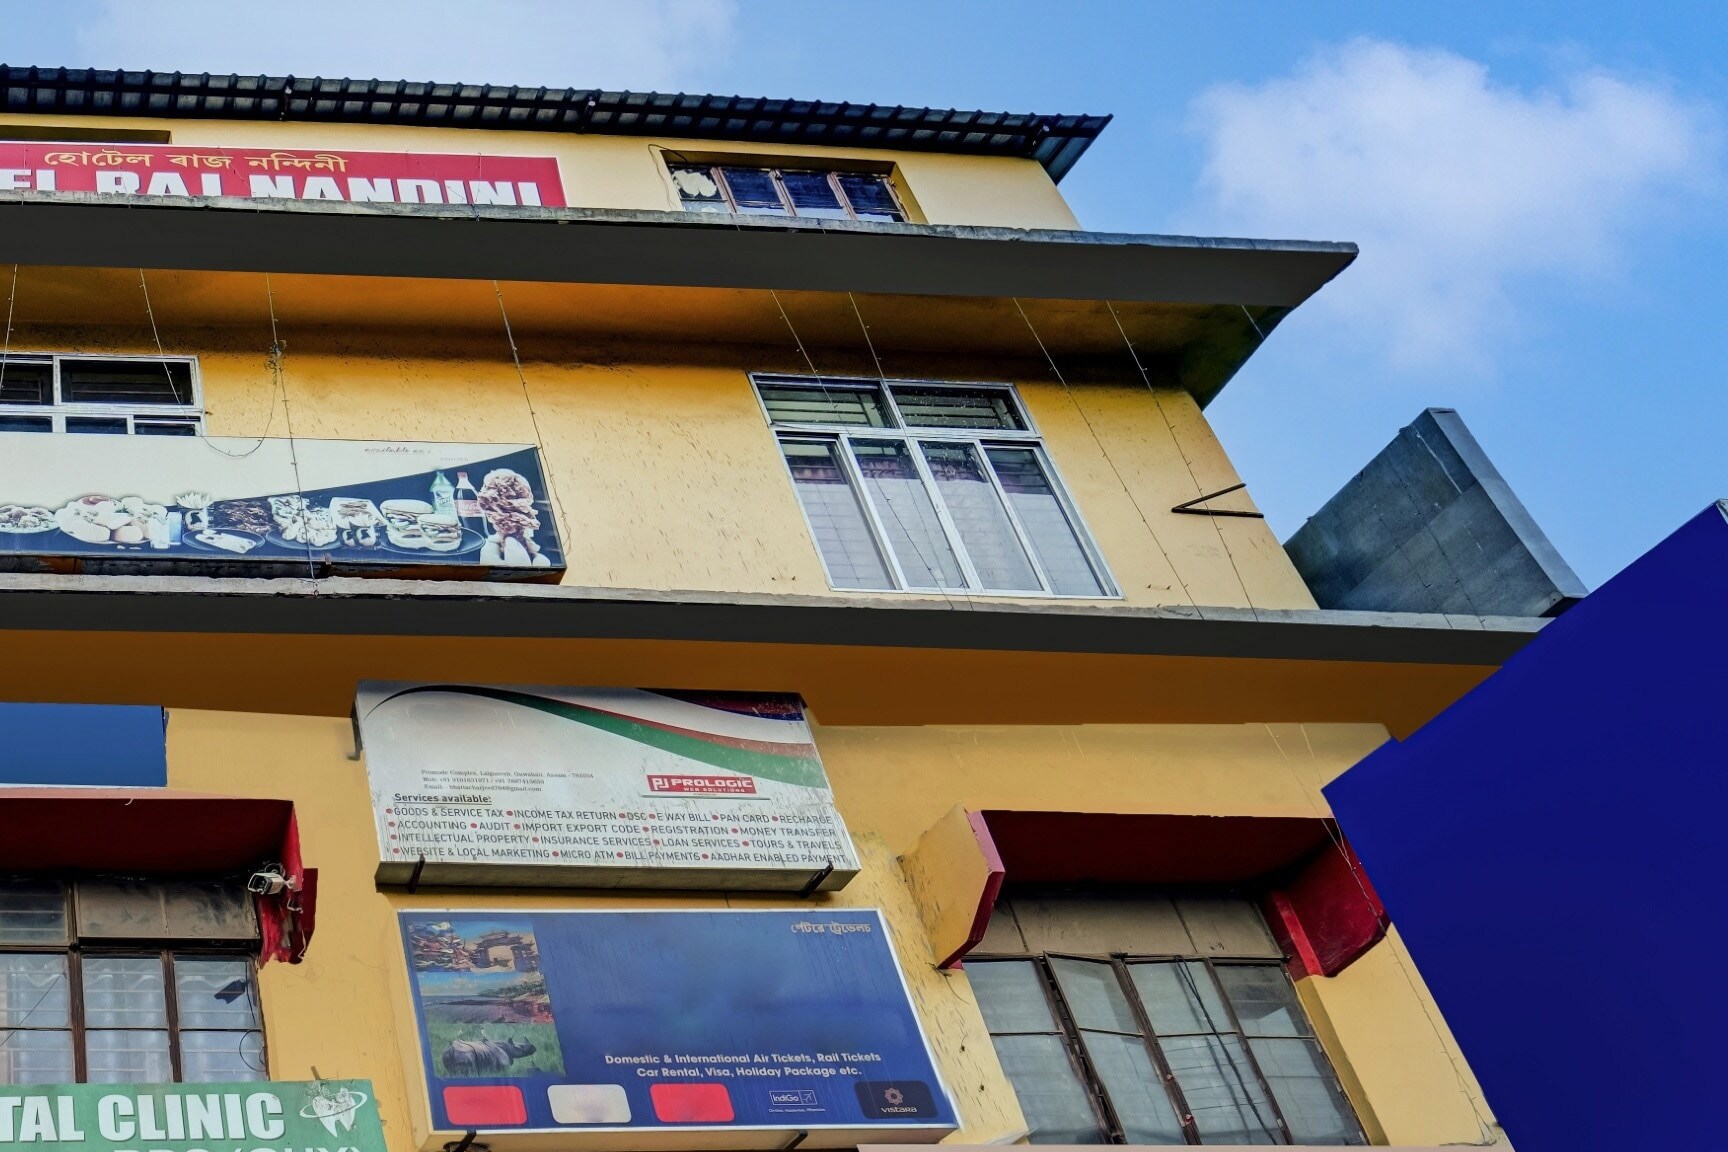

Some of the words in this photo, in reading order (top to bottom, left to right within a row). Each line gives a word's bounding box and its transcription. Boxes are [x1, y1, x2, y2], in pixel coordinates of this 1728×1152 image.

[671, 778, 753, 788] PROLOGIC
[394, 793, 439, 803] Services
[442, 794, 492, 804] available:
[394, 807, 429, 816] GOODS
[431, 808, 439, 816] &
[440, 808, 483, 817] SERVICE
[485, 809, 505, 818] TAX
[514, 809, 553, 819] INCOME
[555, 810, 573, 819] TAX
[576, 811, 617, 820] RETURN
[627, 812, 647, 821] DSC
[657, 813, 664, 821] E
[665, 813, 686, 822] WAY
[689, 813, 711, 822] BILL
[720, 814, 741, 823] PAN
[742, 814, 770, 823] CARD
[779, 815, 832, 824] RECHARGE
[398, 821, 467, 830] ACCOUNTING
[479, 822, 511, 831] AUDIT
[522, 822, 564, 832] IMPORT
[566, 824, 610, 833] EXPORT
[612, 825, 640, 834] CODE
[651, 825, 729, 835] REGISTRATION
[740, 827, 777, 836] MONEY
[779, 828, 836, 837] TRANSFER
[399, 833, 474, 843] INTELLECTUAL
[476, 834, 529, 844] PROPERTY
[541, 836, 599, 845] INSURANCE
[602, 837, 651, 847] SERVICES
[661, 838, 689, 847] LOAN
[691, 839, 741, 848] SERVICES
[749, 840, 785, 849] TOURS
[787, 841, 794, 849] &
[796, 841, 842, 850] TRAVELS
[401, 847, 444, 857] WEBSITE
[447, 848, 455, 857] &
[457, 848, 490, 858] LOCAL
[491, 849, 550, 859] MARKETING
[560, 850, 591, 859] MICRO
[594, 851, 615, 860] ATM
[625, 851, 647, 860] BILL
[648, 852, 701, 862] PAYMENTS
[711, 853, 752, 862] AADHAR
[754, 854, 799, 863] ENABLED
[605, 1053, 661, 1064] Domestic
[664, 1055, 673, 1064] &
[675, 1053, 750, 1064] International
[753, 1053, 770, 1063] Air
[771, 1053, 815, 1064] Tickets,
[817, 1052, 840, 1063] Rail
[842, 1052, 881, 1062] Tickets
[636, 1067, 659, 1077] Car
[662, 1067, 703, 1078] Rental,
[705, 1067, 731, 1078] Visa,
[735, 1066, 781, 1079] Holiday
[784, 1066, 837, 1078] Package
[839, 1065, 862, 1076] etc.
[97, 1092, 286, 1142] CLINIC
